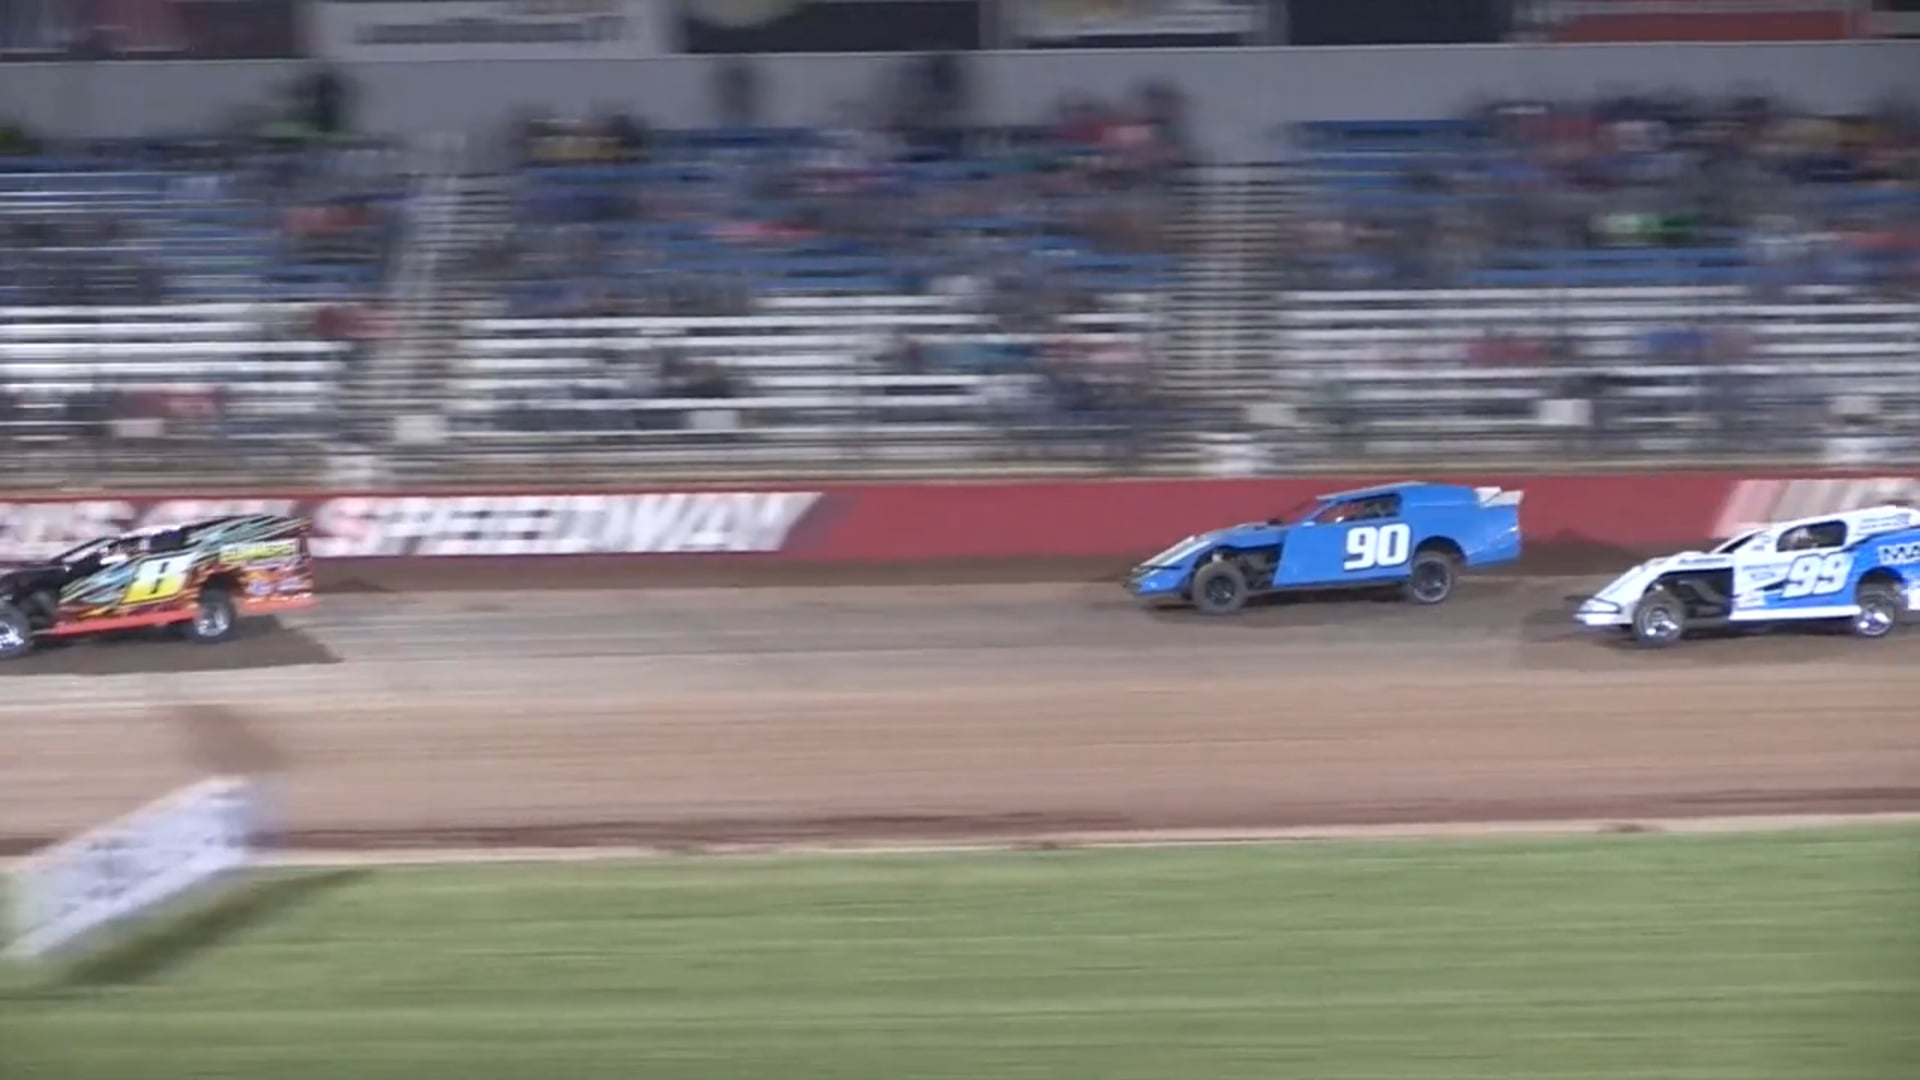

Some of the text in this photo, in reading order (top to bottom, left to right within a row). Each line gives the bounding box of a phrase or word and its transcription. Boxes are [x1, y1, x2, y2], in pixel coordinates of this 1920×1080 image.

[307, 492, 822, 557] SPEEDWAY
[1344, 523, 1411, 571] 90
[1782, 553, 1855, 598] 99
